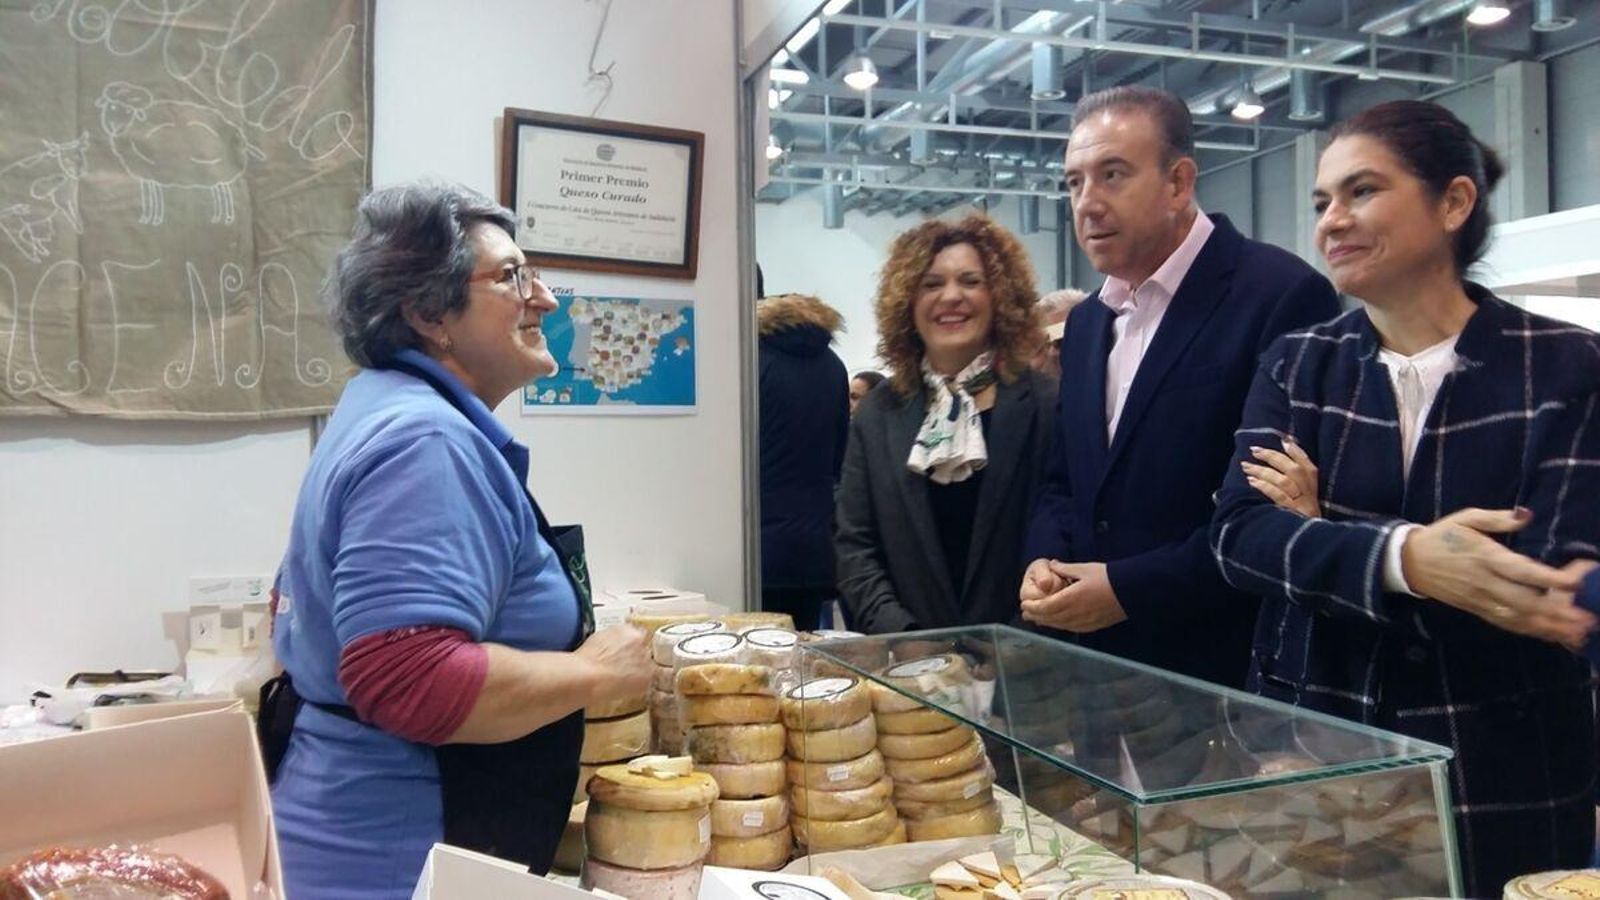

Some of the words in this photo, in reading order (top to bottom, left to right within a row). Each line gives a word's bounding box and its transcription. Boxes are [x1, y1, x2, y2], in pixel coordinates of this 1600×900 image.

[561, 169, 604, 184] Primer
[606, 174, 649, 189] Premio
[560, 186, 599, 199] Queso
[602, 190, 647, 204] Curado
